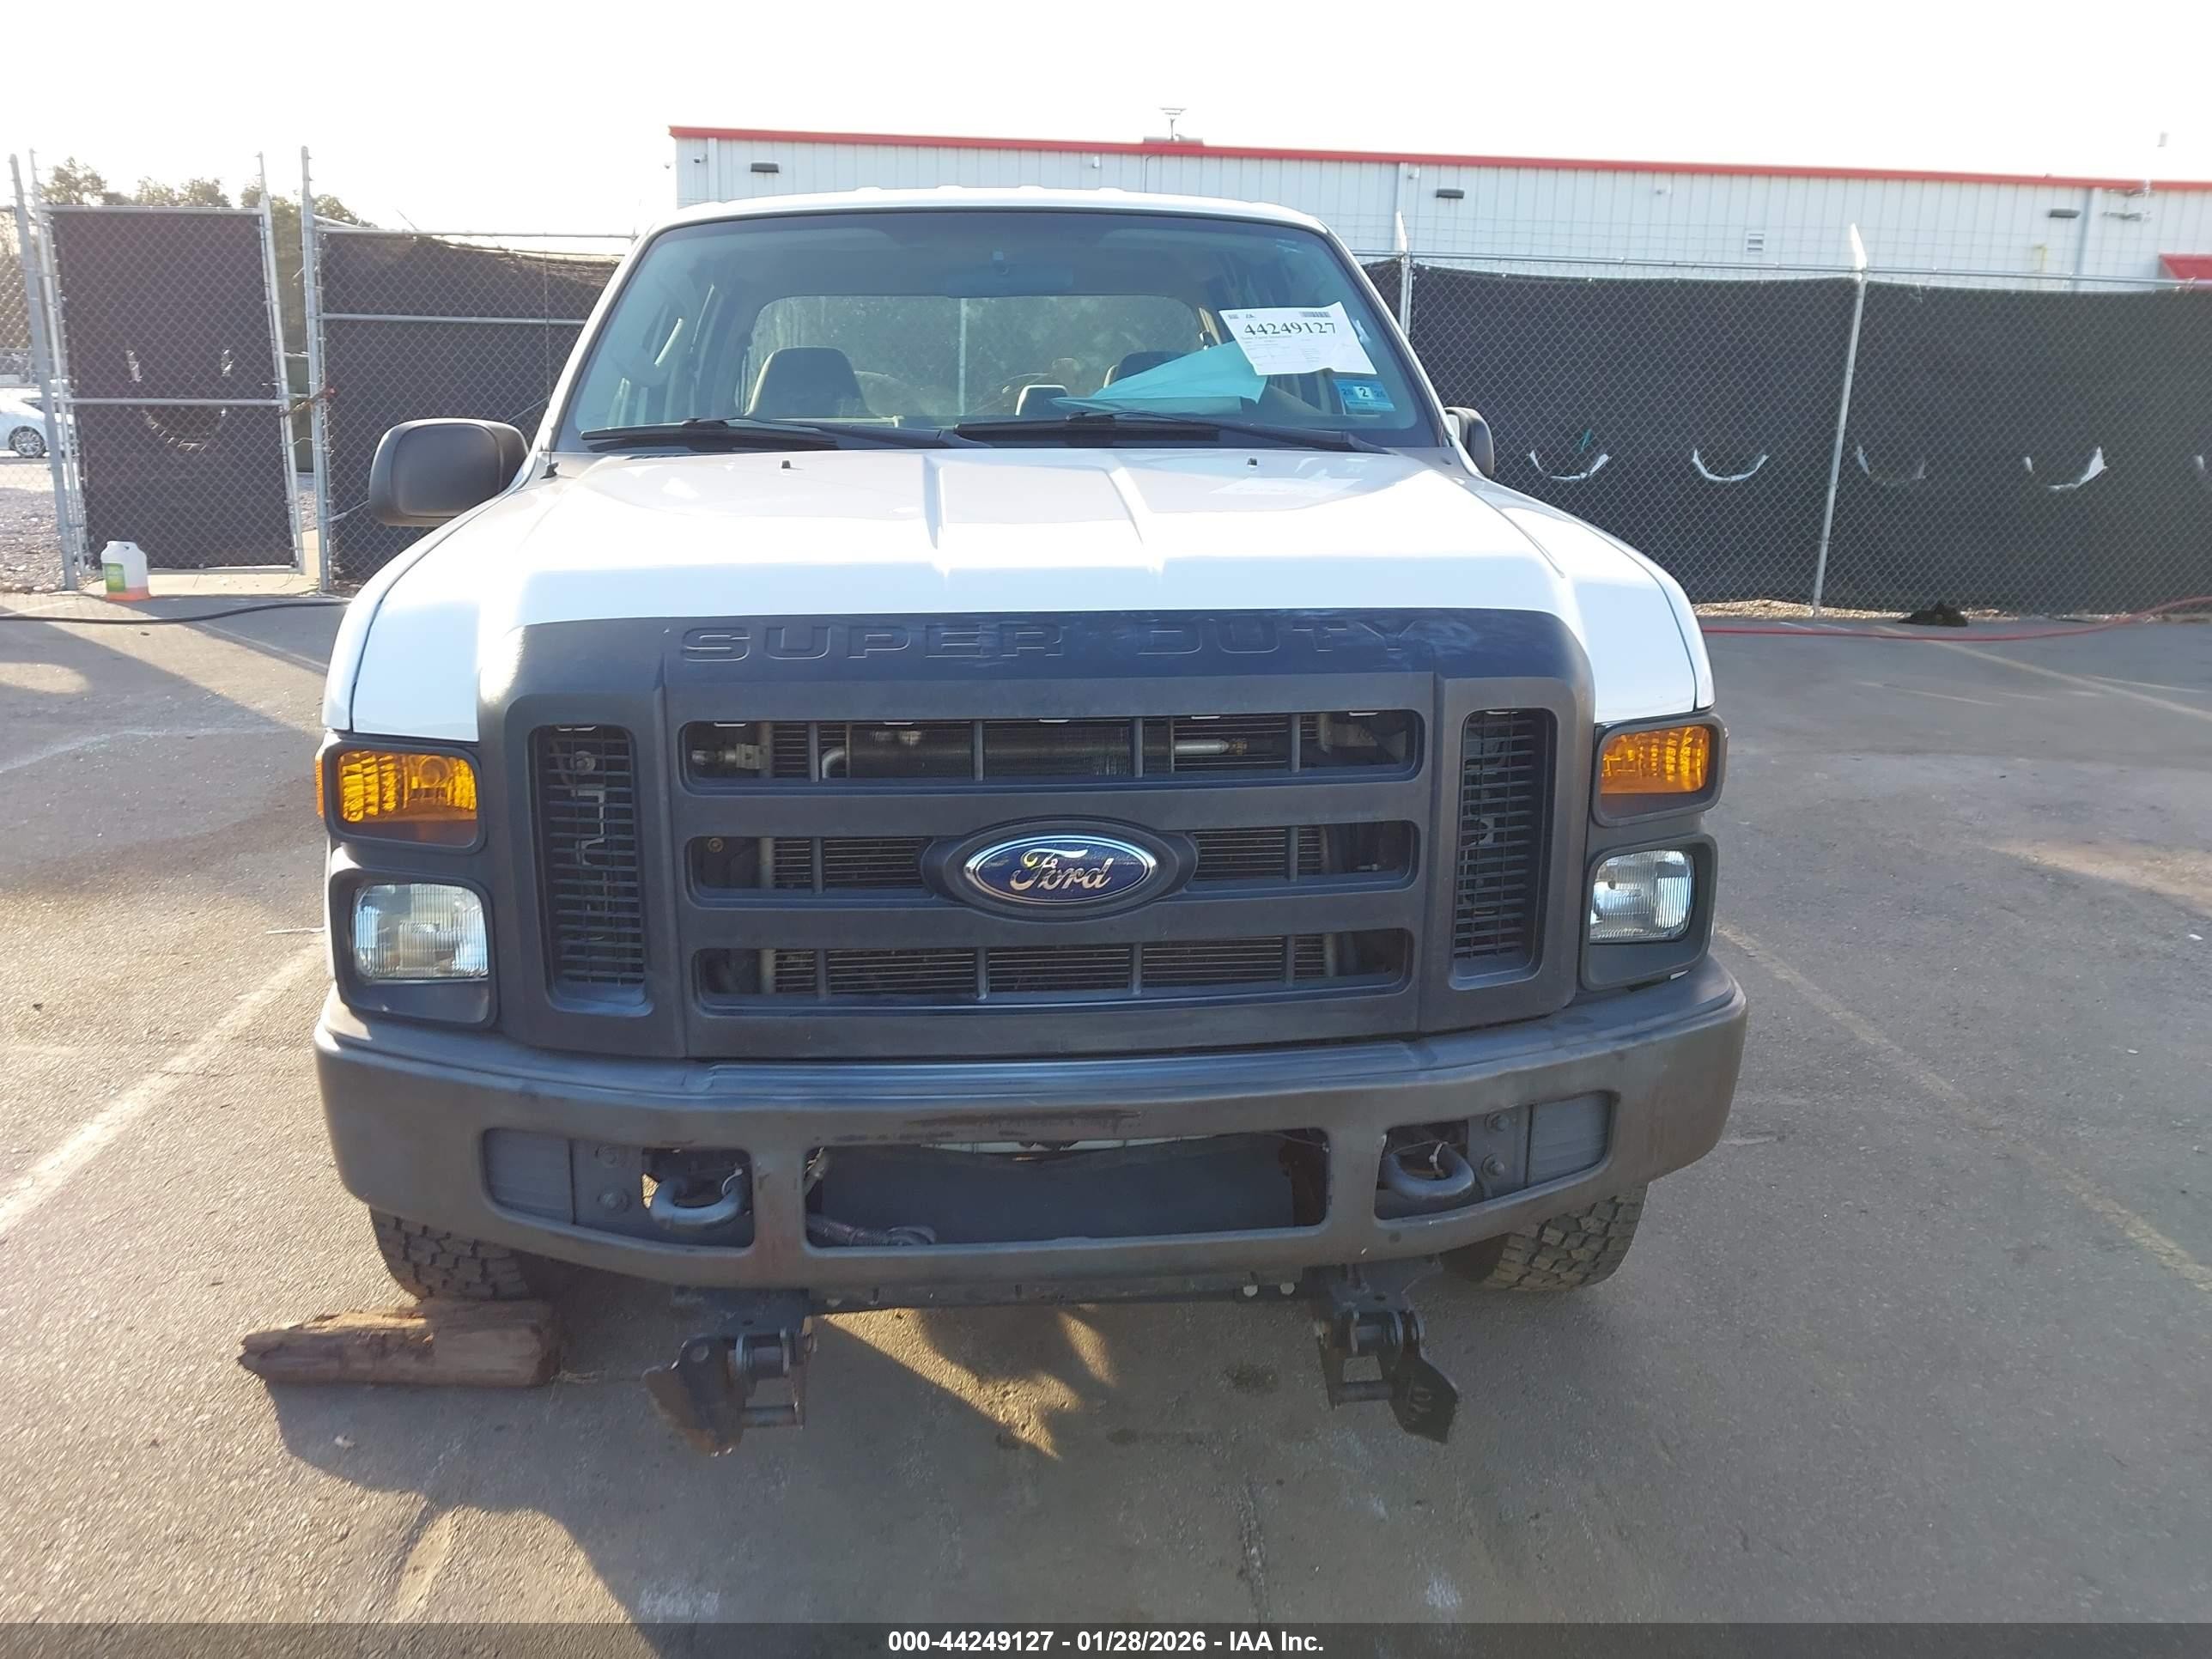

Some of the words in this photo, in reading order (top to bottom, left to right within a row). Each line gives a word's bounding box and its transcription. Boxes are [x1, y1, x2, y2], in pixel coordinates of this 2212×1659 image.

[1243, 322, 1336, 335] 44249127
[1358, 387, 1370, 398] 2
[682, 623, 1063, 662] SUPER
[1135, 617, 1417, 655] DUTY
[1009, 848, 1115, 890] Ford
